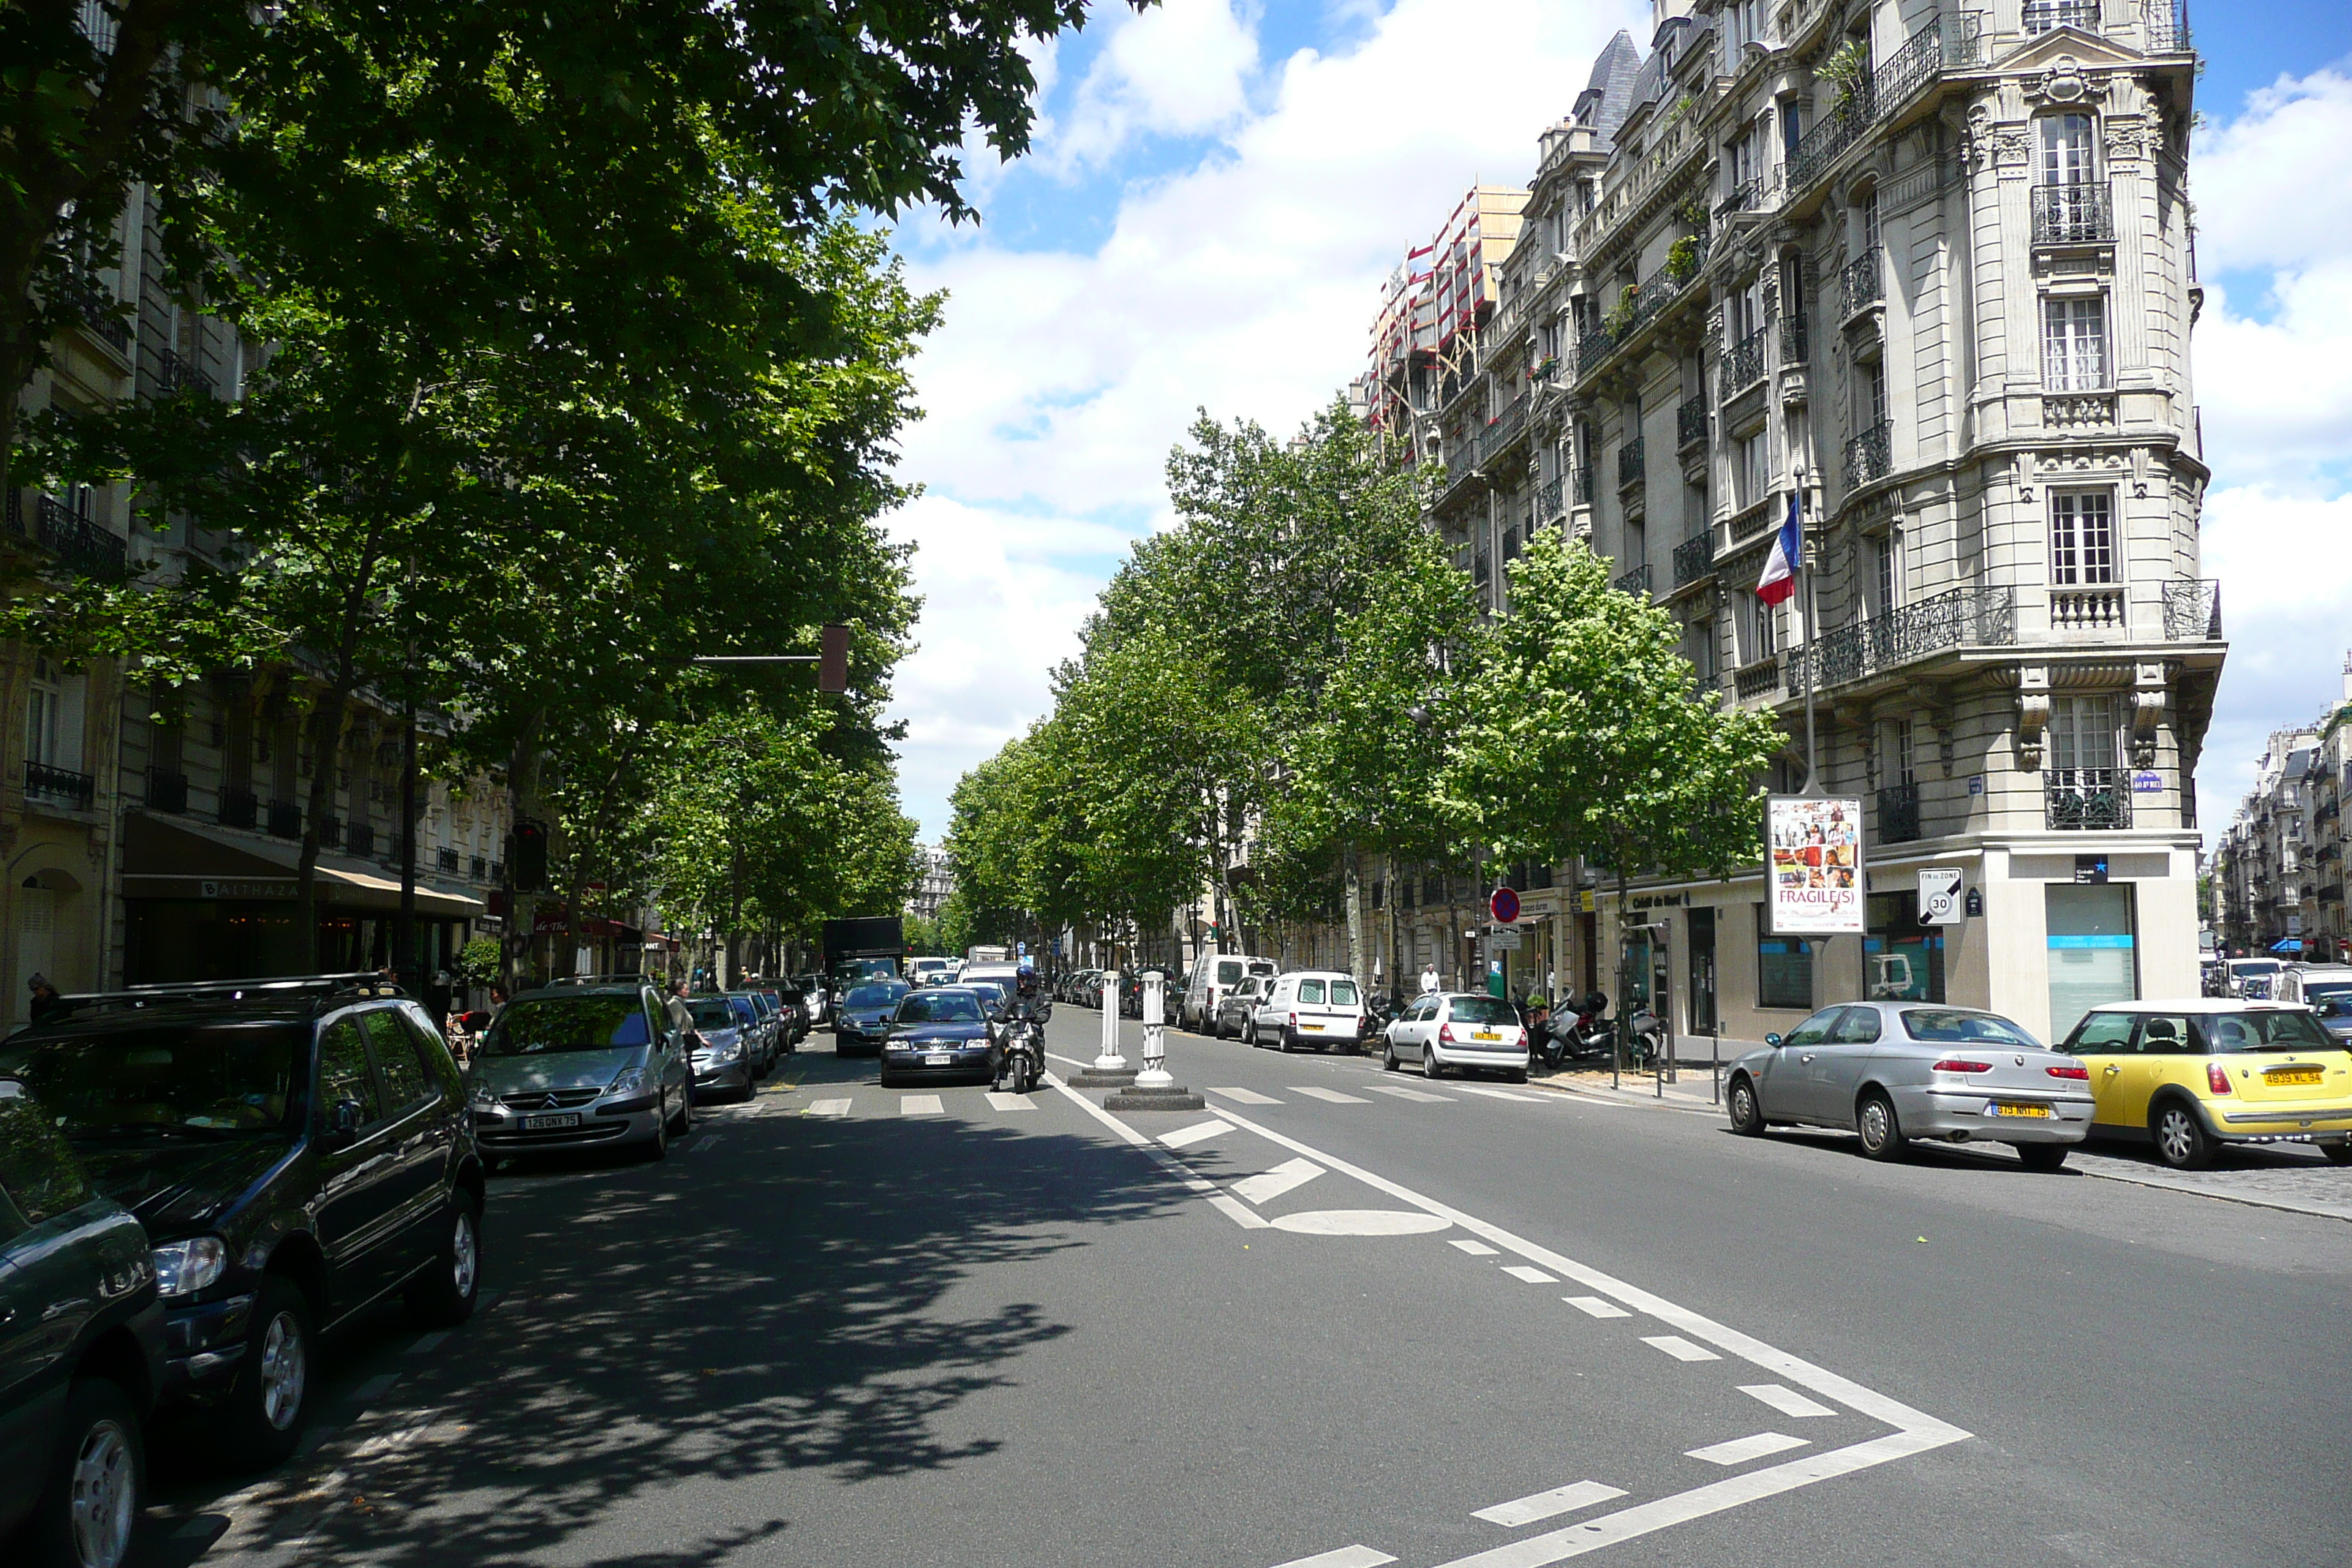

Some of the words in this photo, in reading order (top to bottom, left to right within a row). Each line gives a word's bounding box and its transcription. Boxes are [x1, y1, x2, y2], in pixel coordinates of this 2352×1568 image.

[204, 882, 299, 897] BALTHAZA
[1779, 890, 1855, 905] FRAGILE(S)
[1933, 899, 1947, 908] 30
[2309, 1072, 2321, 1082] 94
[2036, 1107, 2046, 1116] 75
[527, 1117, 544, 1128] 126
[564, 1115, 576, 1125] 75
